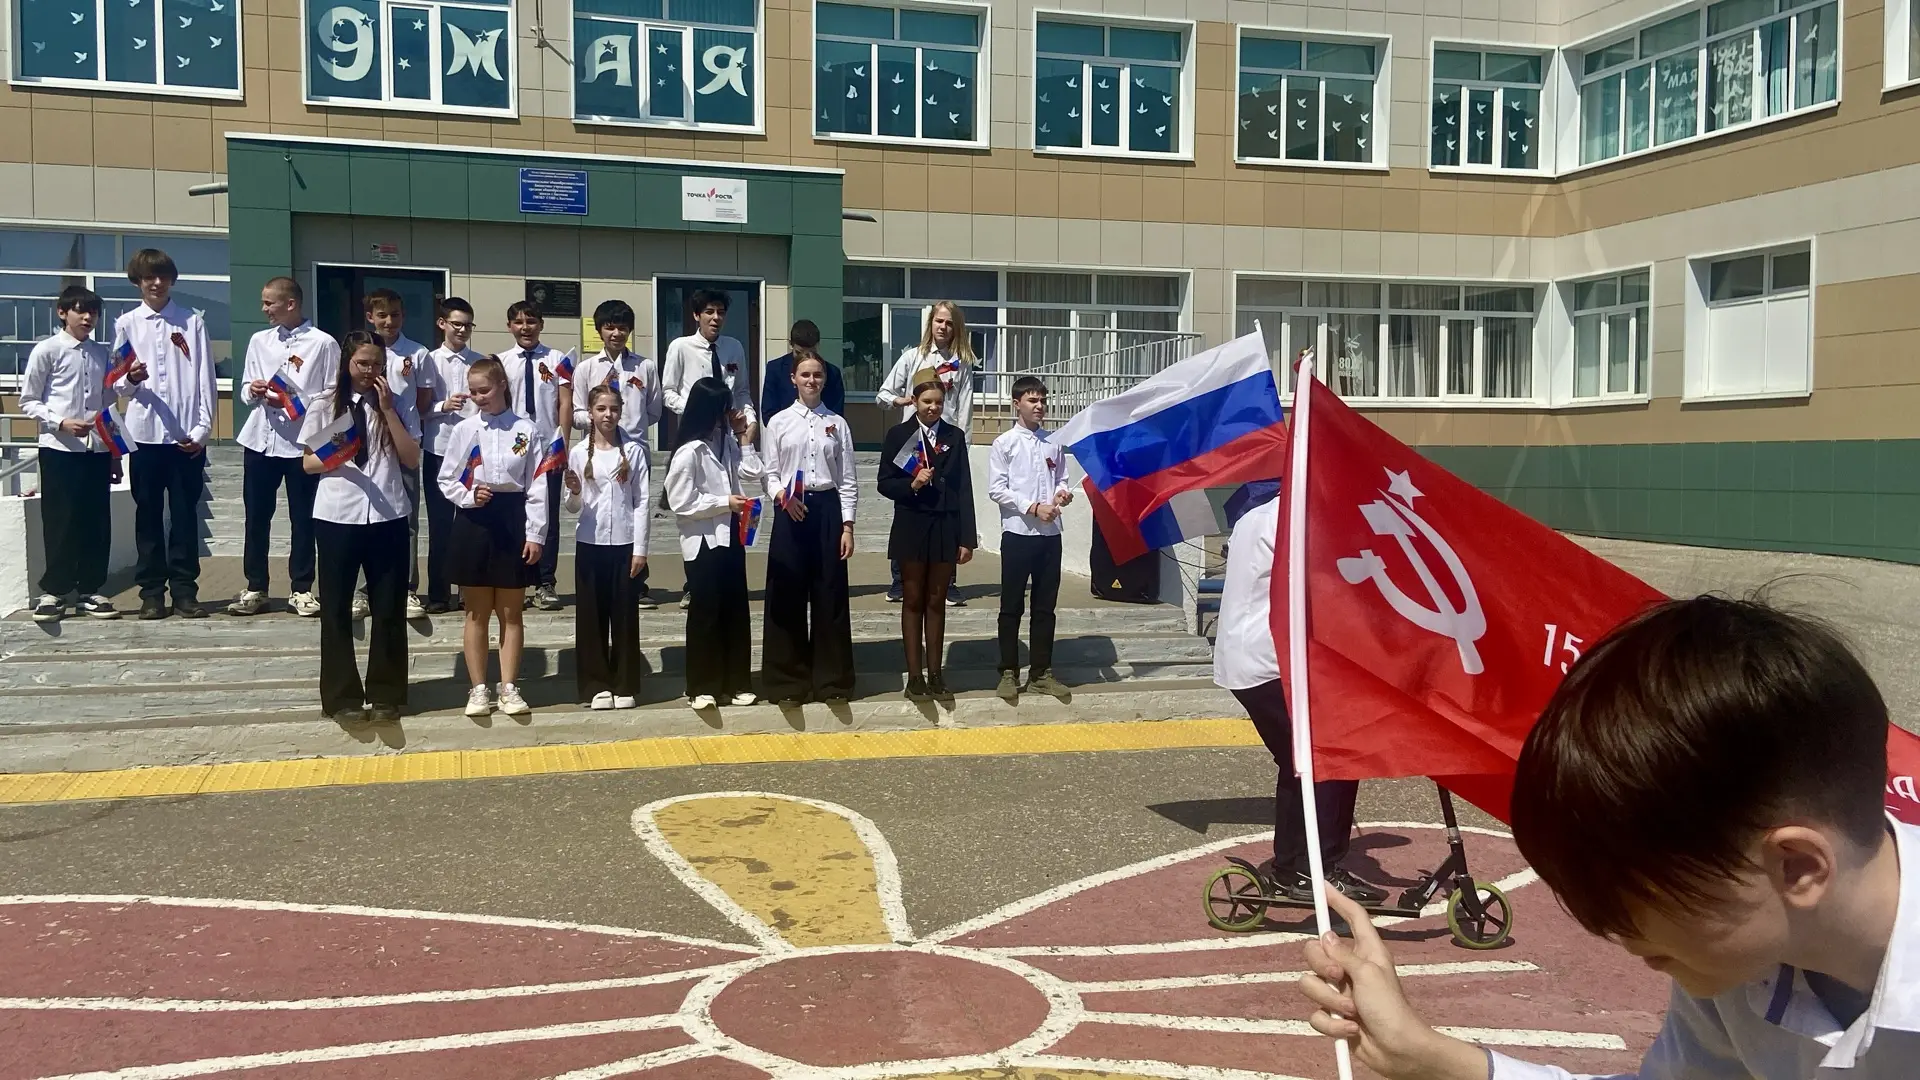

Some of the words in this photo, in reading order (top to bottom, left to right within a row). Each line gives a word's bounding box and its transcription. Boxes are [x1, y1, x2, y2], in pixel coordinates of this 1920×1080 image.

[317, 6, 374, 82] 9
[446, 22, 748, 97] МАЯ
[1661, 62, 1671, 82] 9
[1667, 67, 1697, 89] МАЯ
[1717, 56, 1753, 83] 1945
[1339, 357, 1351, 369] 80
